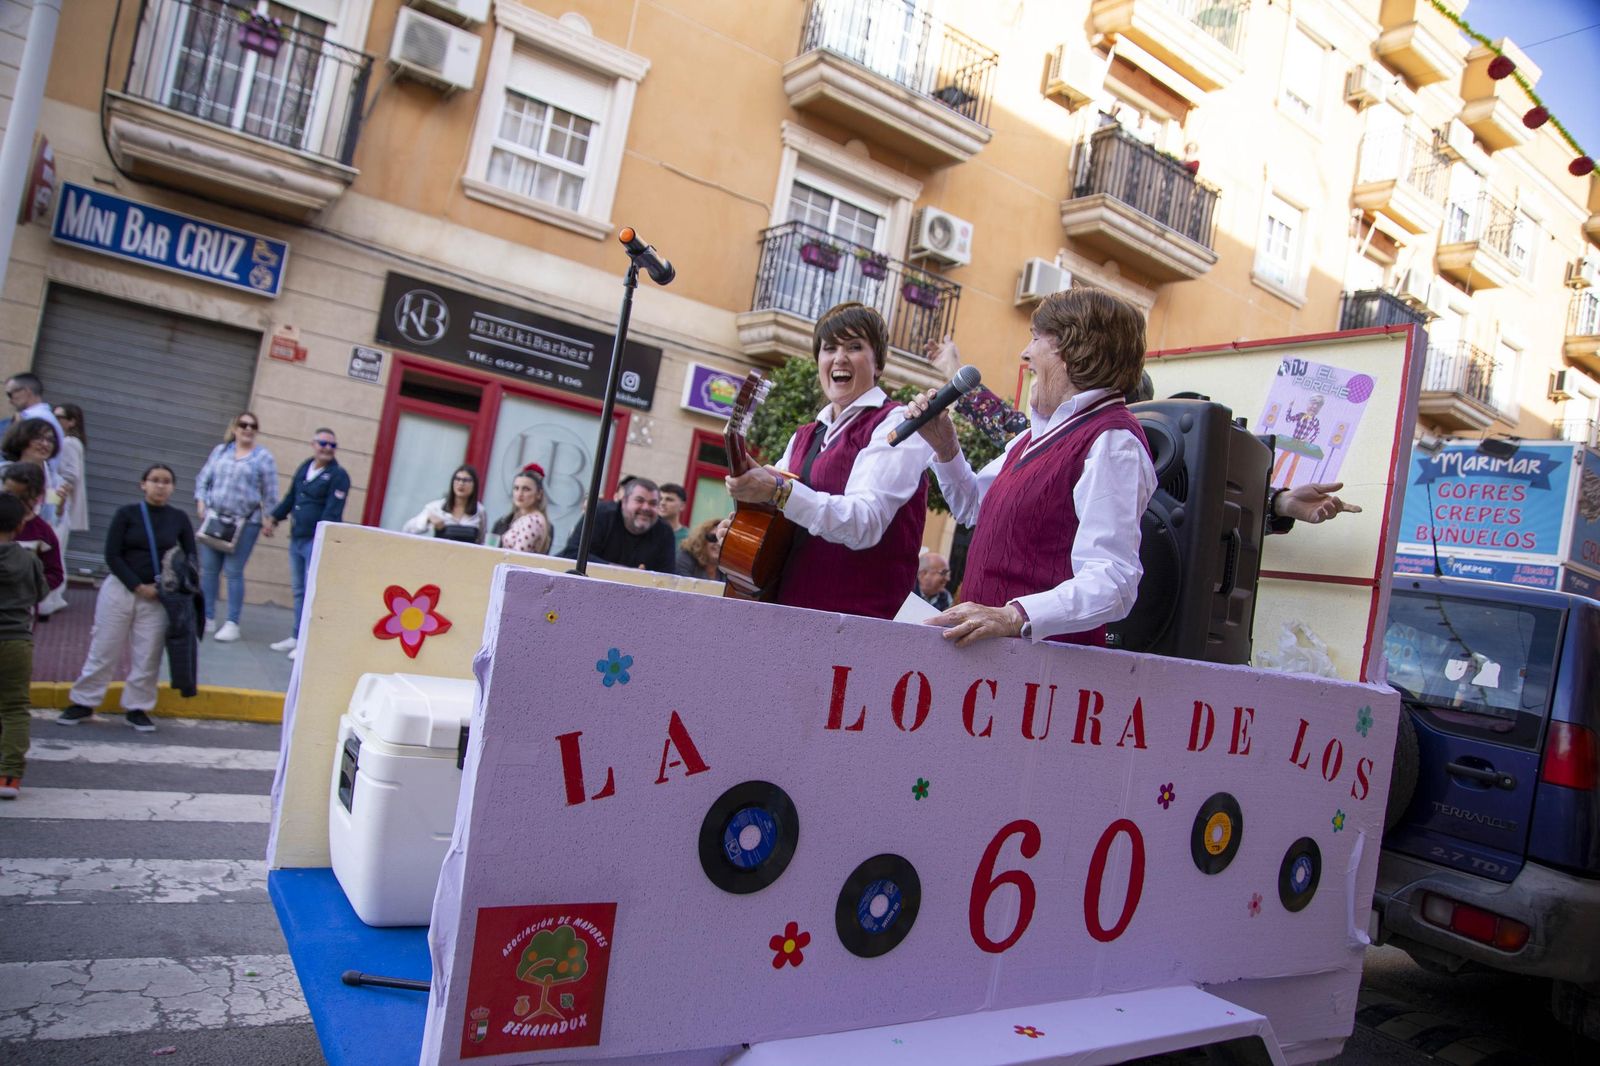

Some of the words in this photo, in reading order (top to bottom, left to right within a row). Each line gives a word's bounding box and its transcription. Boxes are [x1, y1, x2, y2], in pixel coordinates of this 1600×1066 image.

[61, 189, 117, 247] MINI
[120, 206, 171, 262] BAR
[175, 222, 247, 280] CRUZ
[526, 366, 554, 380] 232
[1316, 365, 1337, 381] EL
[1292, 376, 1350, 399] PORCHE
[1438, 482, 1526, 502] GOFRES
[1434, 504, 1522, 525] CREPES
[1416, 523, 1536, 549] BUÑUELOS
[555, 710, 711, 807] LA
[824, 665, 1148, 750] LOCURA
[1186, 700, 1254, 756] DE
[1289, 718, 1374, 801] LOS
[1431, 847, 1464, 861] 2.7
[968, 818, 1146, 954] 60
[557, 915, 571, 925] DE
[573, 917, 608, 948] MAYORES
[502, 1014, 588, 1037] BENAHADUX
